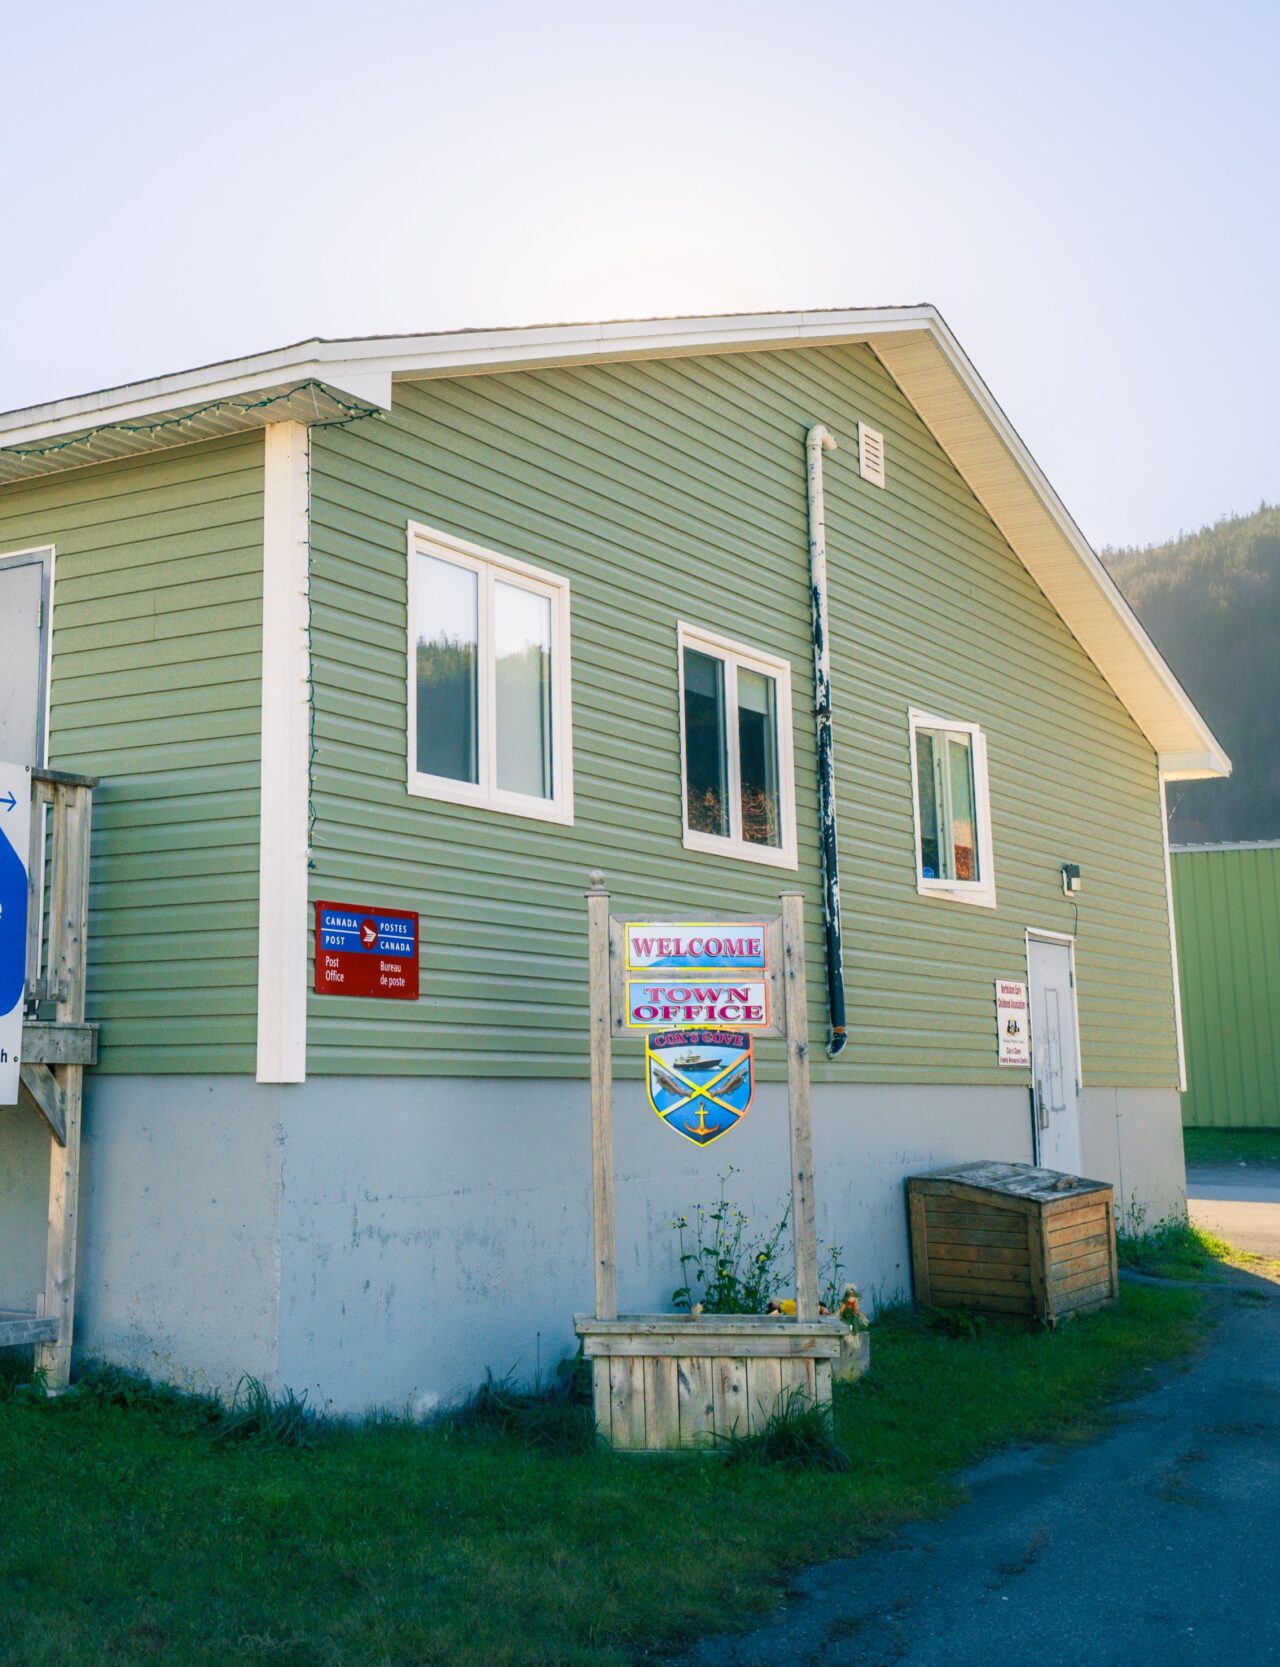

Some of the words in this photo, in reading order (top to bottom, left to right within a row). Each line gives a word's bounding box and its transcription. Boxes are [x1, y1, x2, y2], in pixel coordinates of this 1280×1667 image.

[325, 916, 358, 928] CANADA
[380, 922, 407, 934] POSTES
[325, 935, 345, 945] POST
[380, 940, 411, 952] CANADA
[632, 937, 762, 958] WELCOME
[325, 956, 340, 968] Post
[380, 960, 402, 973] Bureau
[325, 970, 345, 983] Office
[380, 974, 388, 985] de
[388, 977, 406, 988] poste
[644, 987, 751, 1003] TOWN
[632, 1005, 764, 1021] OFFICE
[654, 1031, 699, 1047] COX'S
[702, 1031, 744, 1047] COVE
